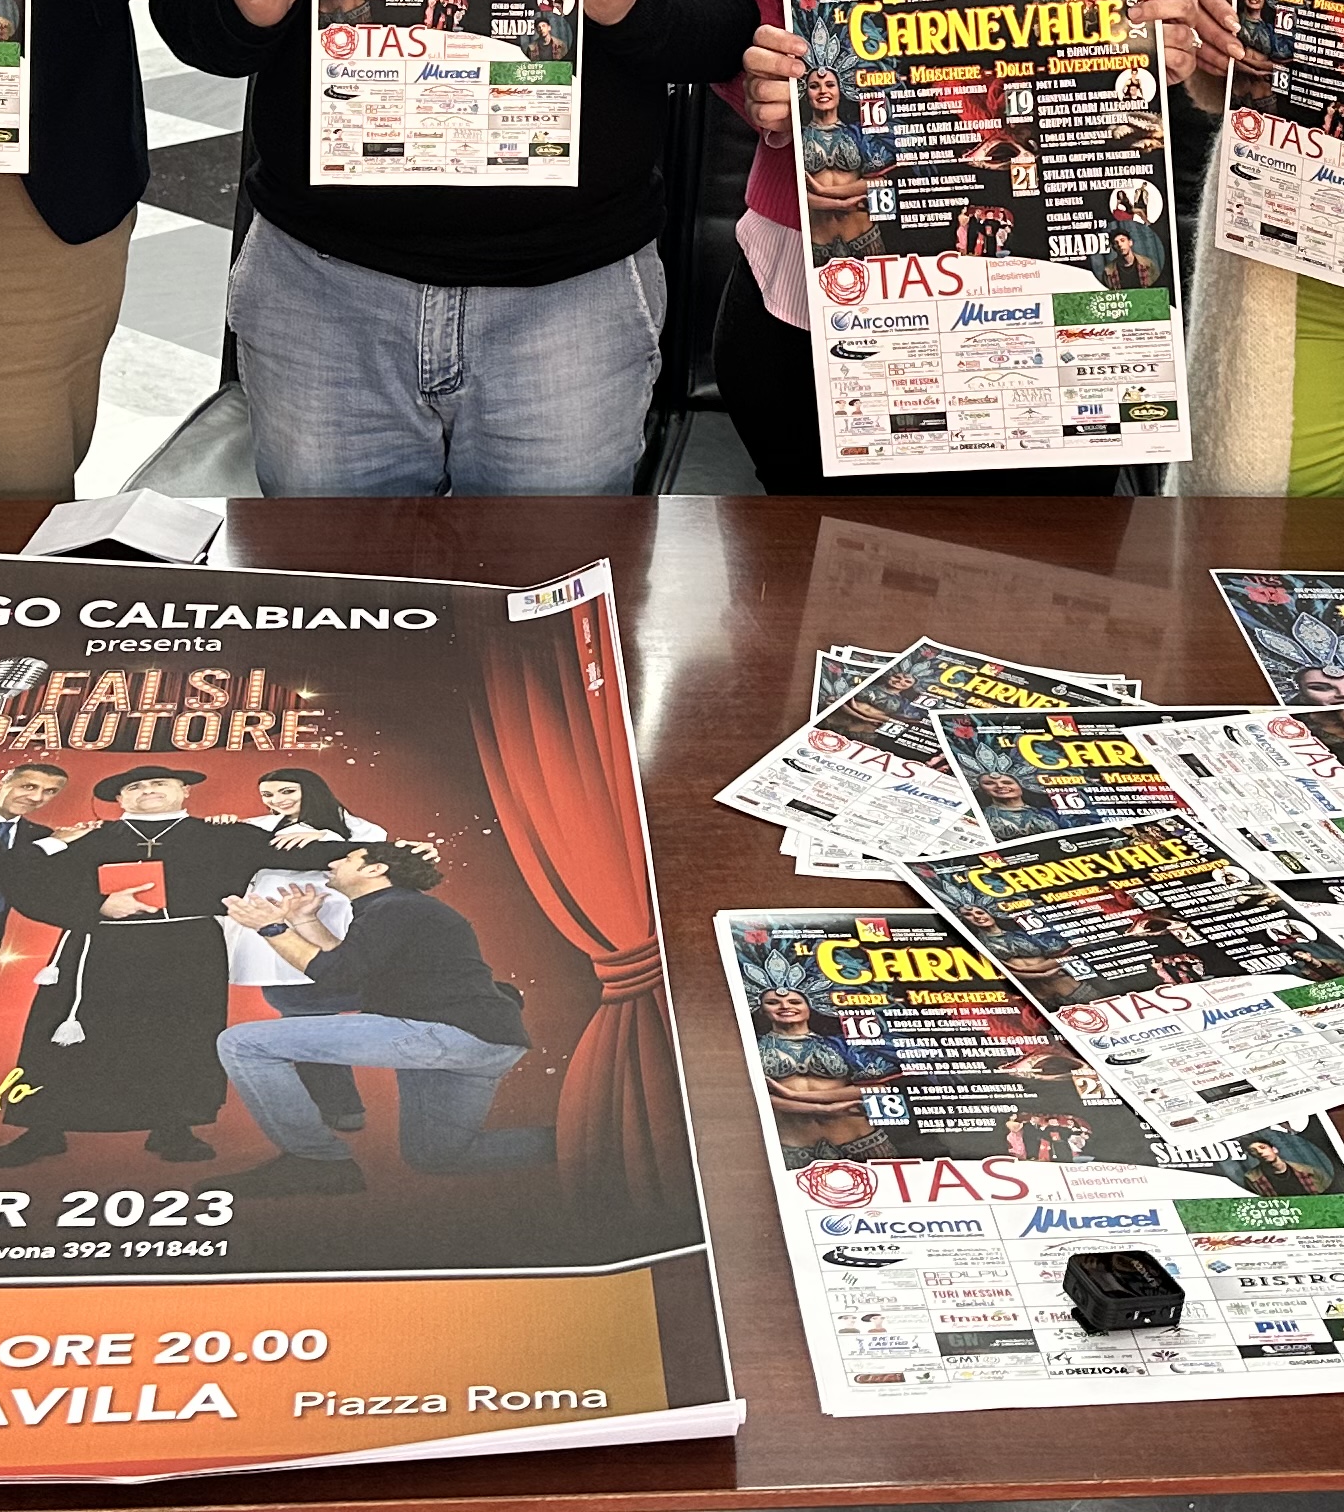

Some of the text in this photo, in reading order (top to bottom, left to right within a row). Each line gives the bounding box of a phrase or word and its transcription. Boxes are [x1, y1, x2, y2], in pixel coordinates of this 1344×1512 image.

[340, 65, 400, 79] Aircomm
[414, 62, 481, 83] Muracel
[1048, 233, 1111, 258] SHADE
[850, 312, 930, 329] Aircomm
[951, 299, 1041, 331] Muracel
[78, 599, 440, 630] CALTABIANO
[85, 636, 223, 657] presenta
[41, 668, 268, 712] FALSI
[967, 837, 1199, 900] CARNEVALE
[56, 1190, 235, 1228] 2023
[1018, 1205, 1161, 1239] Muracel
[853, 1216, 984, 1237] Aircomm
[62, 1241, 112, 1259] 392
[120, 1240, 229, 1258] 1918461
[153, 1329, 329, 1366] 20.00
[294, 1390, 448, 1417] Piazza
[467, 1384, 608, 1412] Roma
